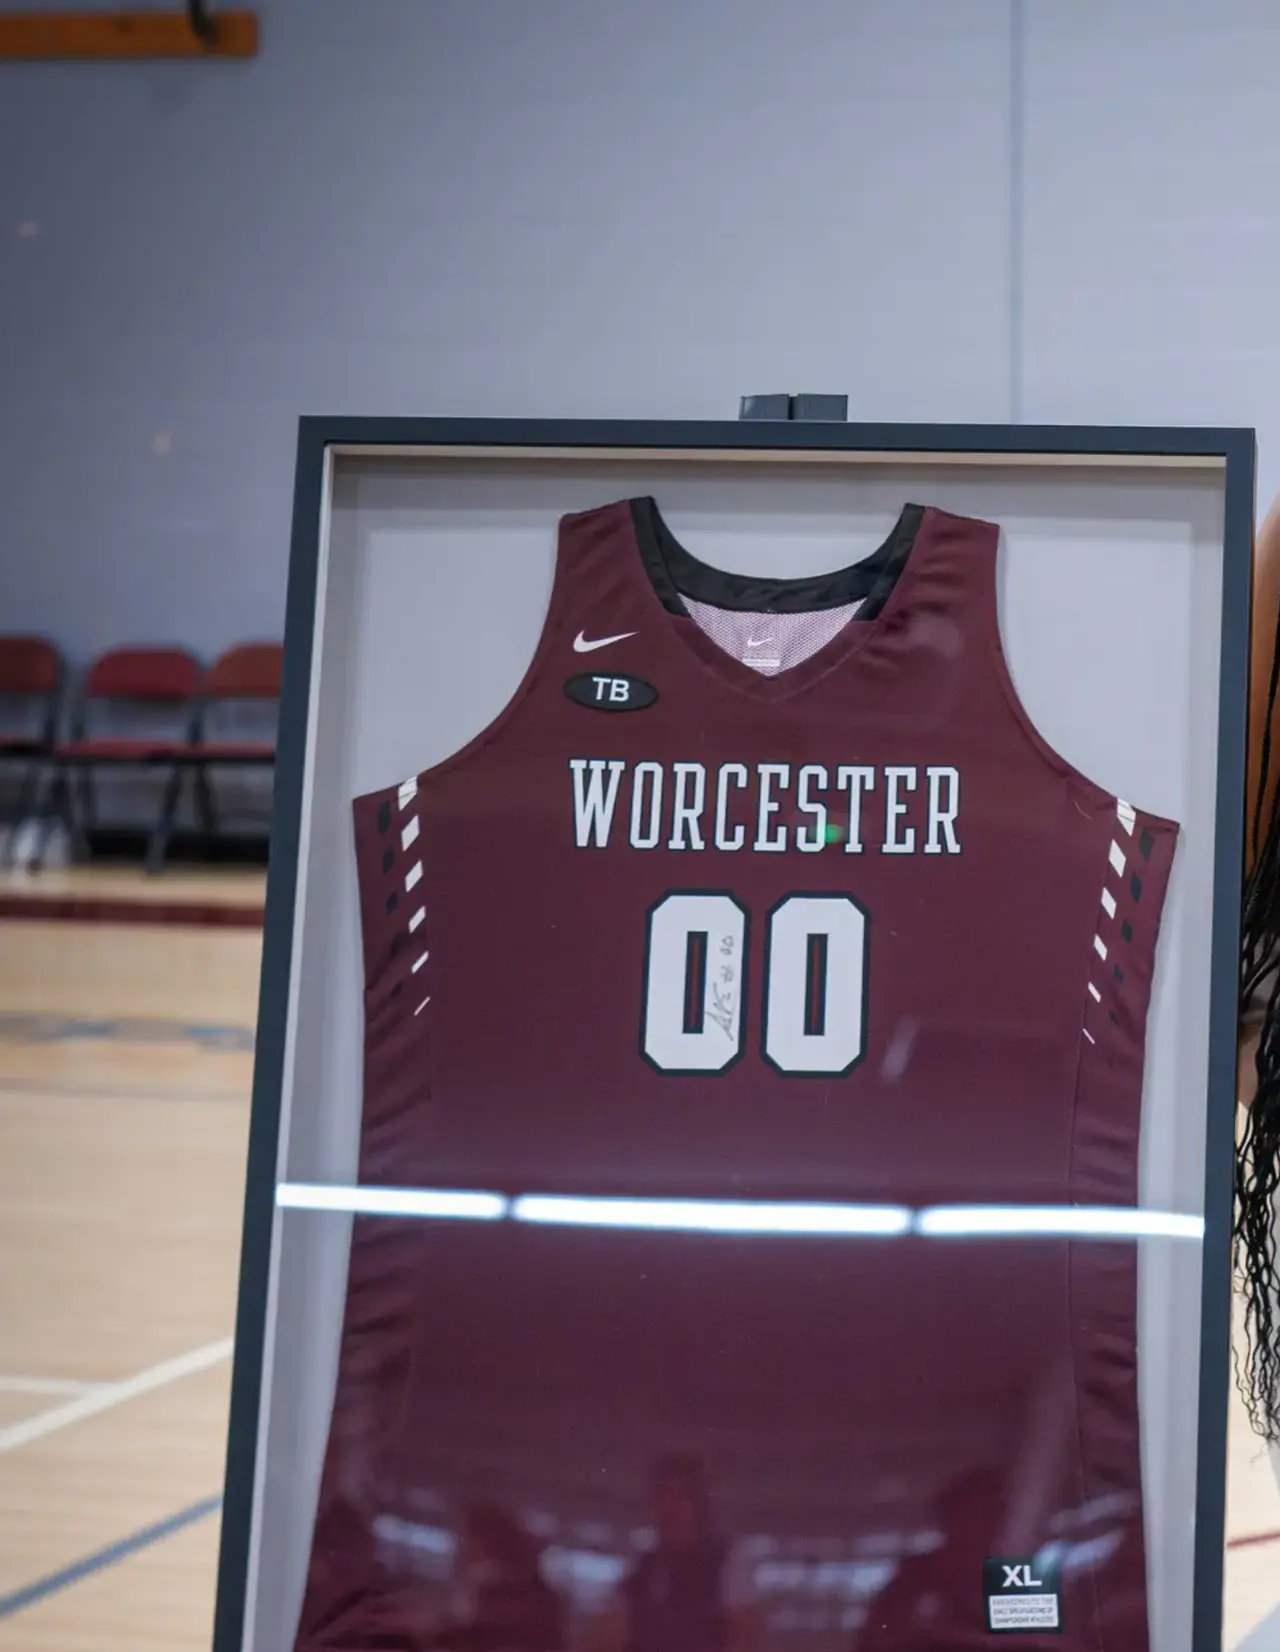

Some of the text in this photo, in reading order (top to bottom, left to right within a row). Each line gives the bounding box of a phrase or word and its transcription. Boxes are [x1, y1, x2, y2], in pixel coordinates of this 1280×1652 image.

[592, 677, 630, 702] TB
[569, 759, 963, 855] WORCESTER
[640, 889, 871, 1077] 00
[1002, 1565, 1043, 1587] XL
